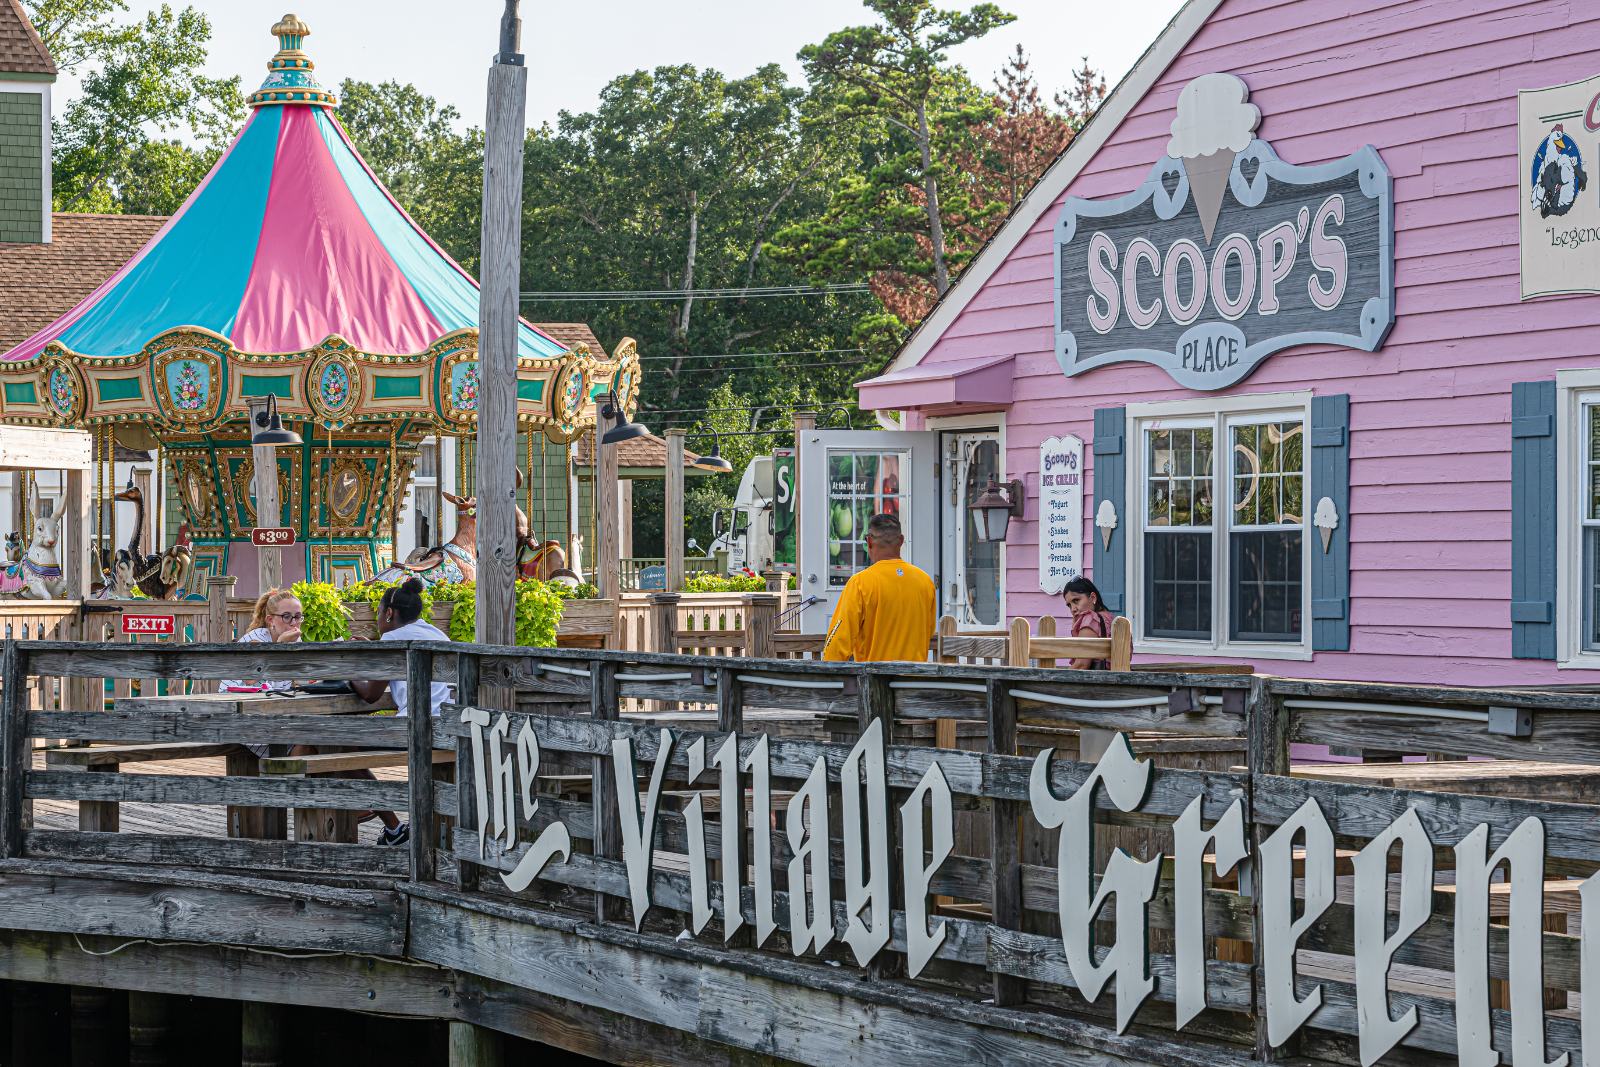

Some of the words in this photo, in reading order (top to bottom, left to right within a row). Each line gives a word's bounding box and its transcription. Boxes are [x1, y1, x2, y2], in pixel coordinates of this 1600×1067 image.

[1087, 194, 1348, 334] SCOOP'S
[1182, 336, 1238, 373] PLACE
[1042, 474, 1054, 486] ICE
[1055, 473, 1079, 486] CREAM
[838, 481, 847, 490] the
[847, 481, 860, 490] hert
[1050, 499, 1068, 509] Yogurt
[1050, 513, 1066, 523] Sodas
[1050, 526, 1069, 536] Shakes
[259, 531, 289, 544] $3.00
[1050, 540, 1072, 550] Sundaes
[1050, 553, 1072, 562] Pretzels
[1050, 566, 1061, 577] Hot
[1062, 566, 1076, 577] Dogs
[127, 617, 169, 631] EXIT
[460, 706, 542, 861] The
[611, 716, 955, 980] Village
[1029, 731, 1600, 1067] Green
